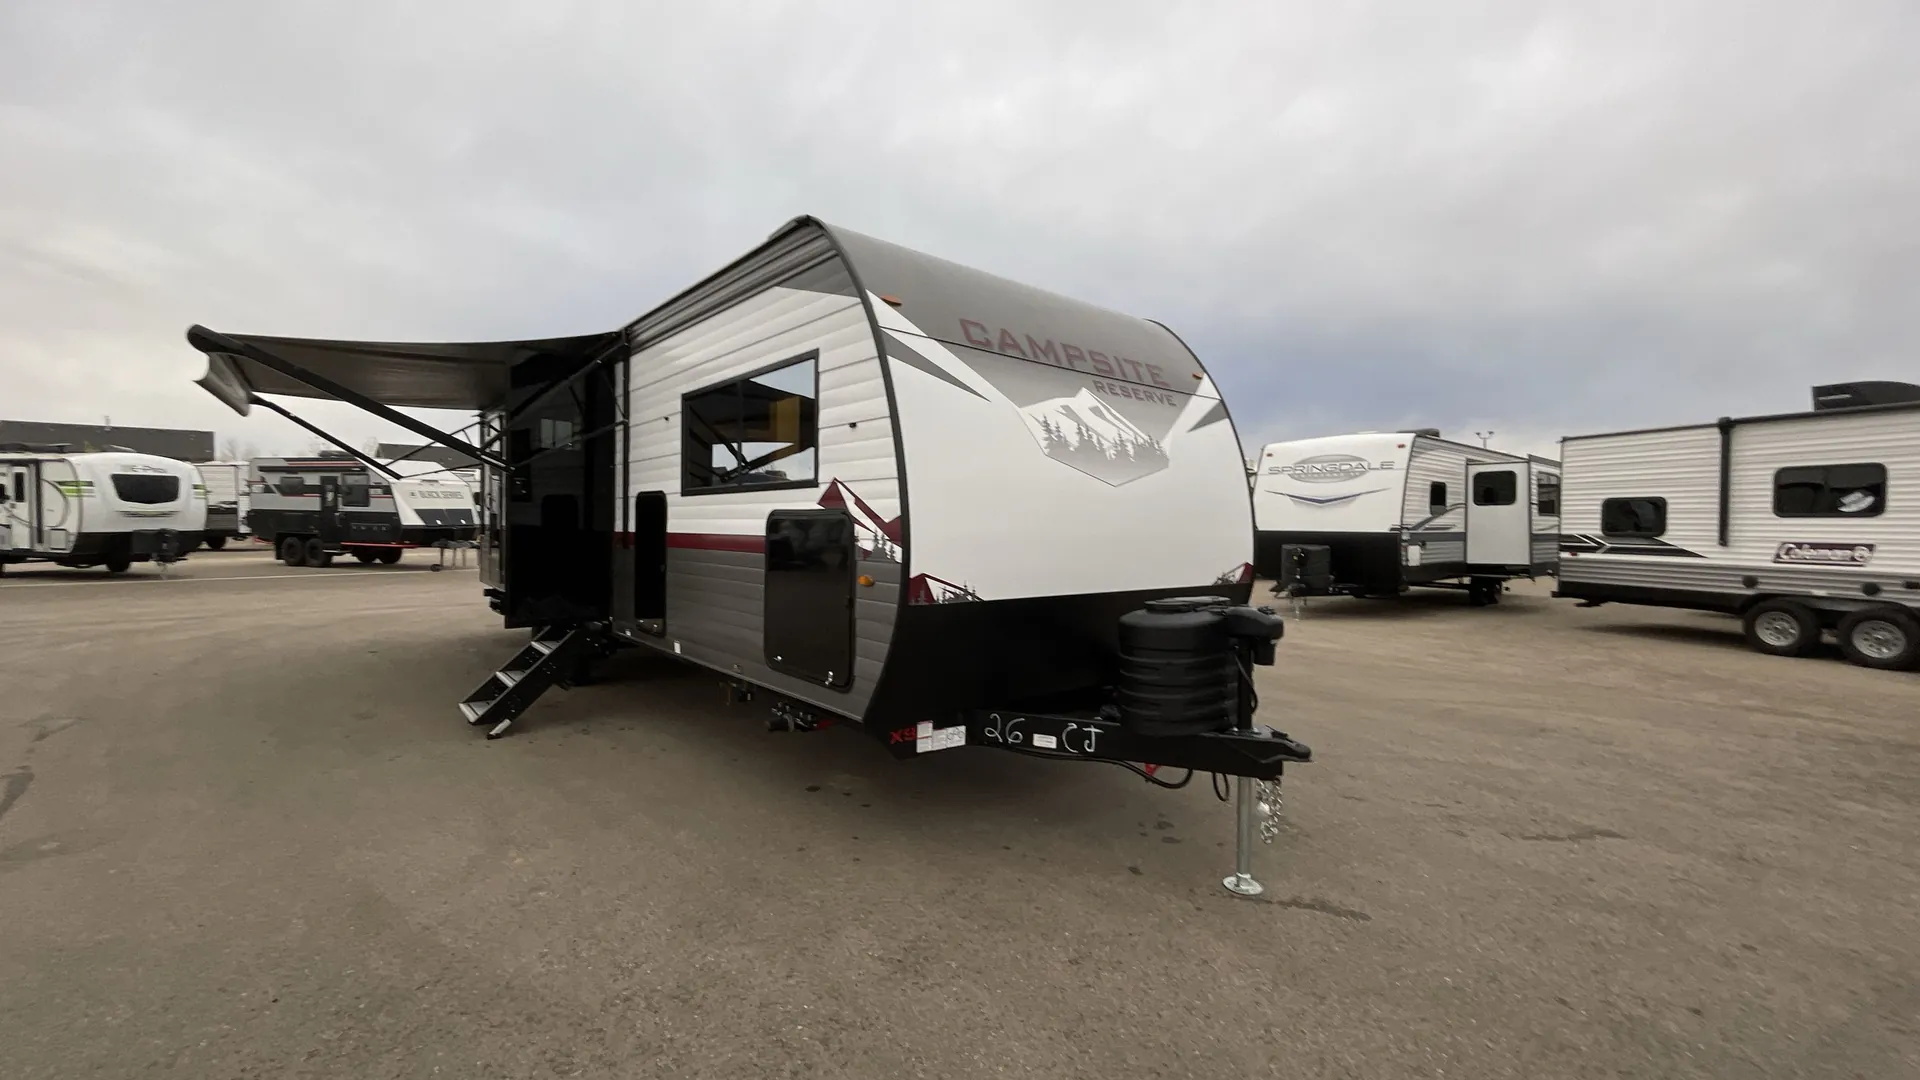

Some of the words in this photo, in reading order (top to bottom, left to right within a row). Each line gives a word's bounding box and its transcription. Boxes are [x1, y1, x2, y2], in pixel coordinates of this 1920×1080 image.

[959, 318, 1171, 388] CAMPSITE
[1092, 379, 1178, 407] RESERVE
[1268, 460, 1395, 475] SPRINGDALE
[1780, 543, 1853, 561] Coleman
[984, 713, 1025, 743] 26
